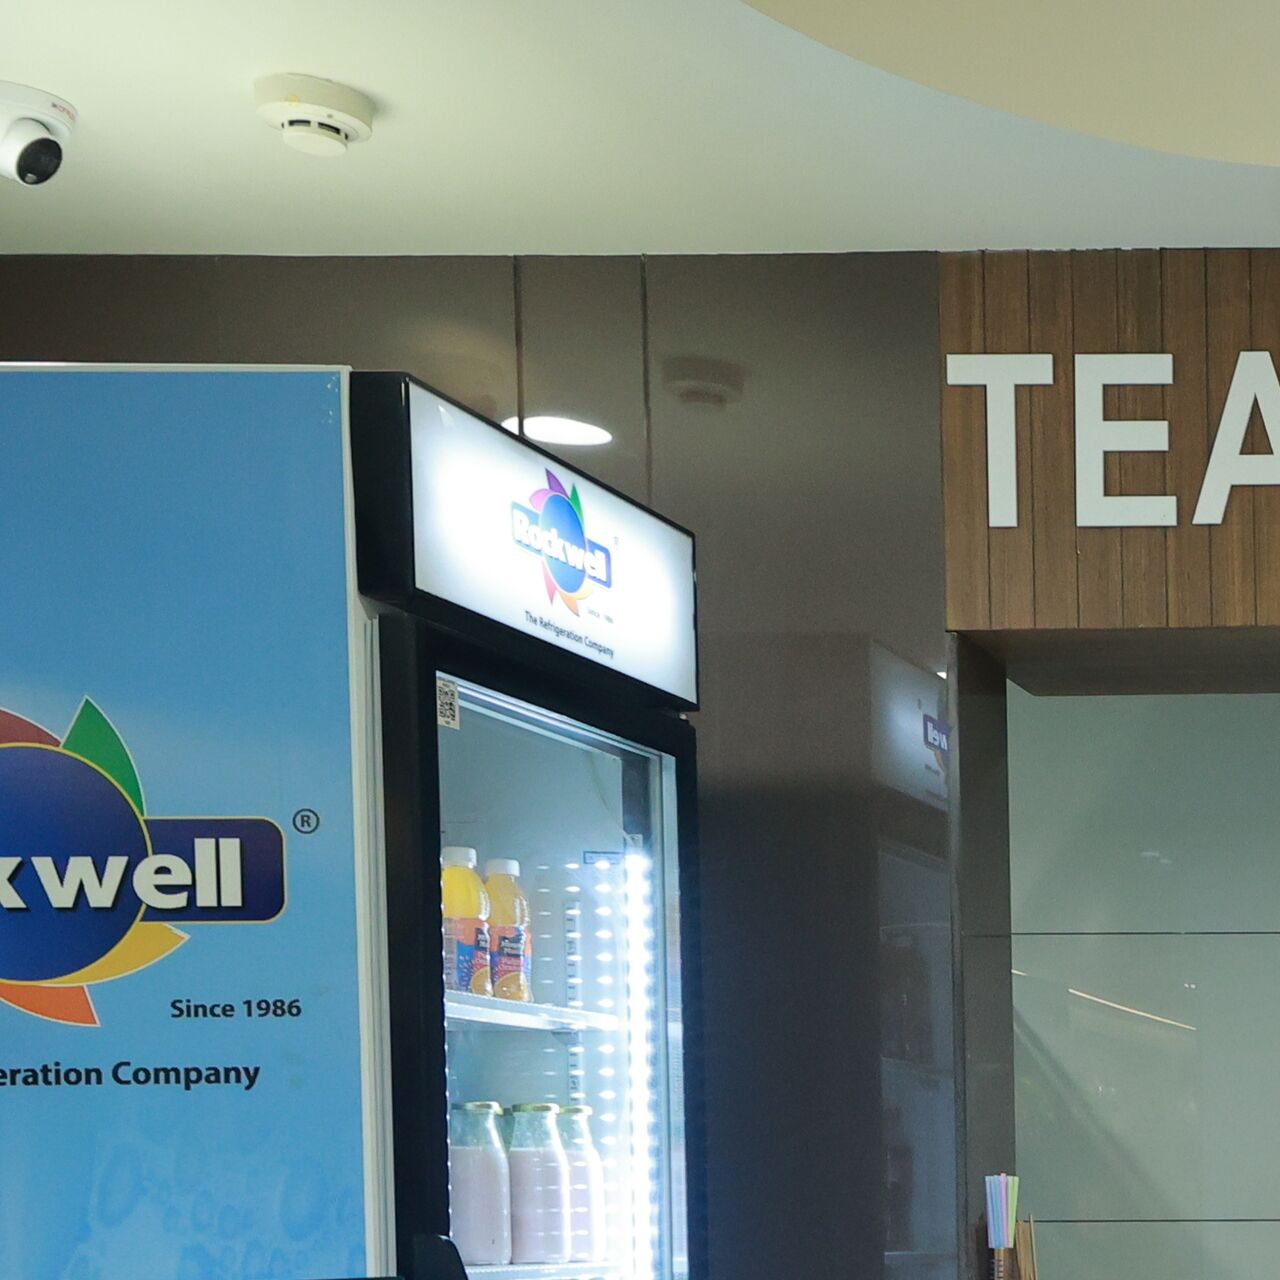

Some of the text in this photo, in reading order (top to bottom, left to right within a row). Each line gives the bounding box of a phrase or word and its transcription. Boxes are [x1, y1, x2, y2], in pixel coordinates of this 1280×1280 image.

[524, 610, 538, 626] The
[538, 616, 584, 643] Refrigeration
[584, 635, 615, 660] Company
[170, 999, 302, 1018] Since 1986
[111, 1061, 260, 1091] Company
